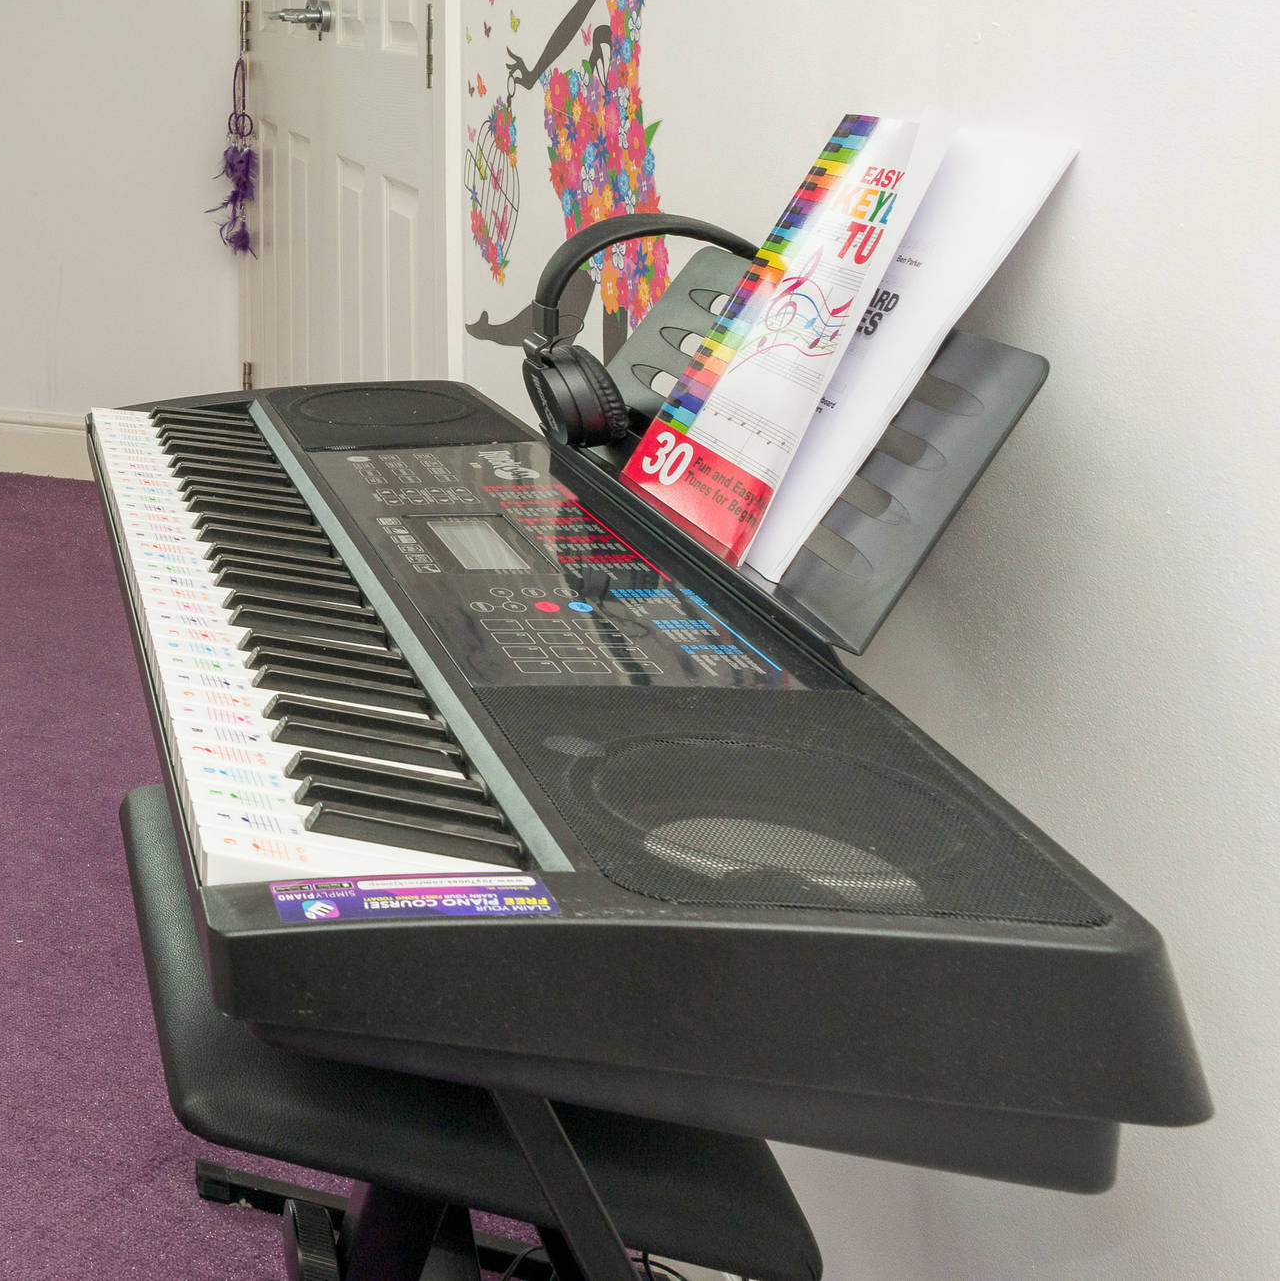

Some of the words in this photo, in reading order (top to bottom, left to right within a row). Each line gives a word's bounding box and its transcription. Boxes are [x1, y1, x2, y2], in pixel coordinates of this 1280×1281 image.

[861, 166, 905, 190] EASY
[642, 432, 694, 486] 30
[692, 457, 712, 476] Fun
[711, 470, 733, 488] and
[732, 481, 756, 506] Easy
[685, 470, 712, 496] Tunes
[712, 489, 728, 505] for
[364, 899, 438, 910] COURSE!
[442, 898, 500, 907] PIANO
[504, 897, 549, 905] FREE
